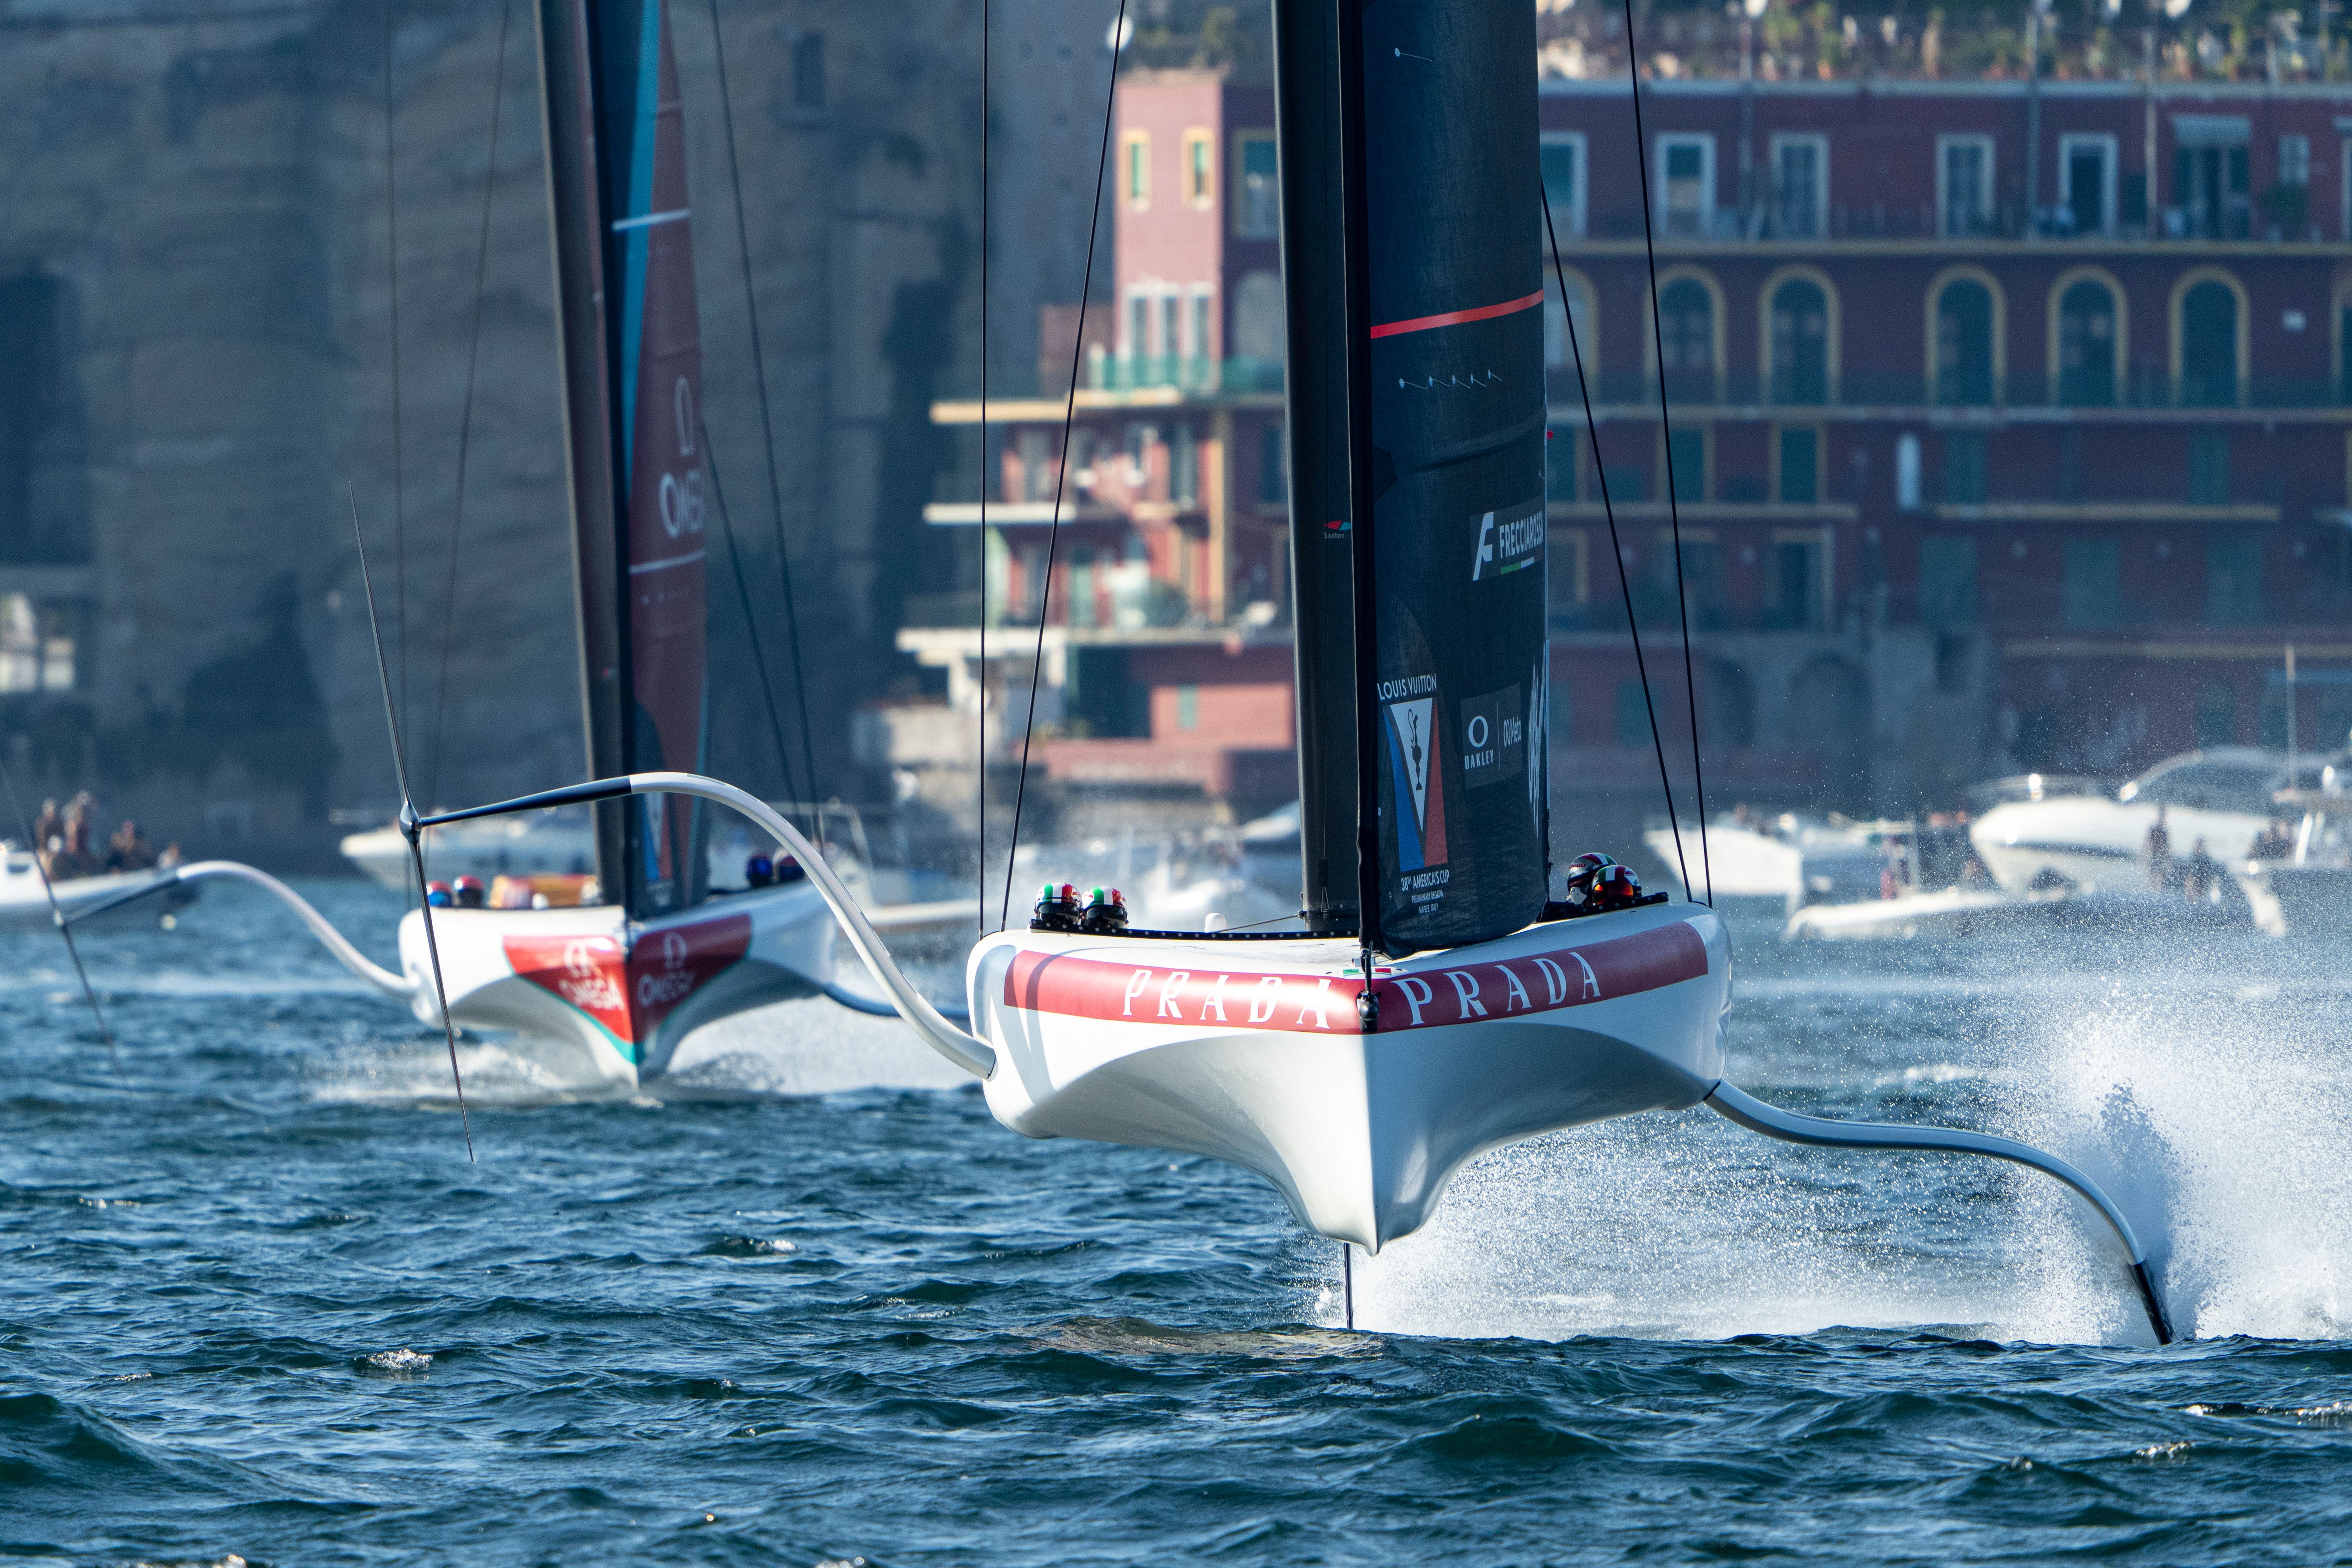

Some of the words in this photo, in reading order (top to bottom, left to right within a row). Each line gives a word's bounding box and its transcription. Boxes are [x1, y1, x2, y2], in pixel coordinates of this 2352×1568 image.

[1377, 679, 1407, 700] LOUIS
[1407, 673, 1437, 695] VUITTON
[1464, 749, 1494, 770] OAKLEY
[1401, 876, 1412, 891] 38TH
[1413, 871, 1440, 889] AMERICA'S
[1440, 869, 1449, 884] CUP
[1412, 892, 1431, 903] PRELIMINARY
[1431, 889, 1444, 900] REGATTA
[1122, 969, 1333, 1029] PRADA
[1390, 952, 1601, 1026] PRADA
